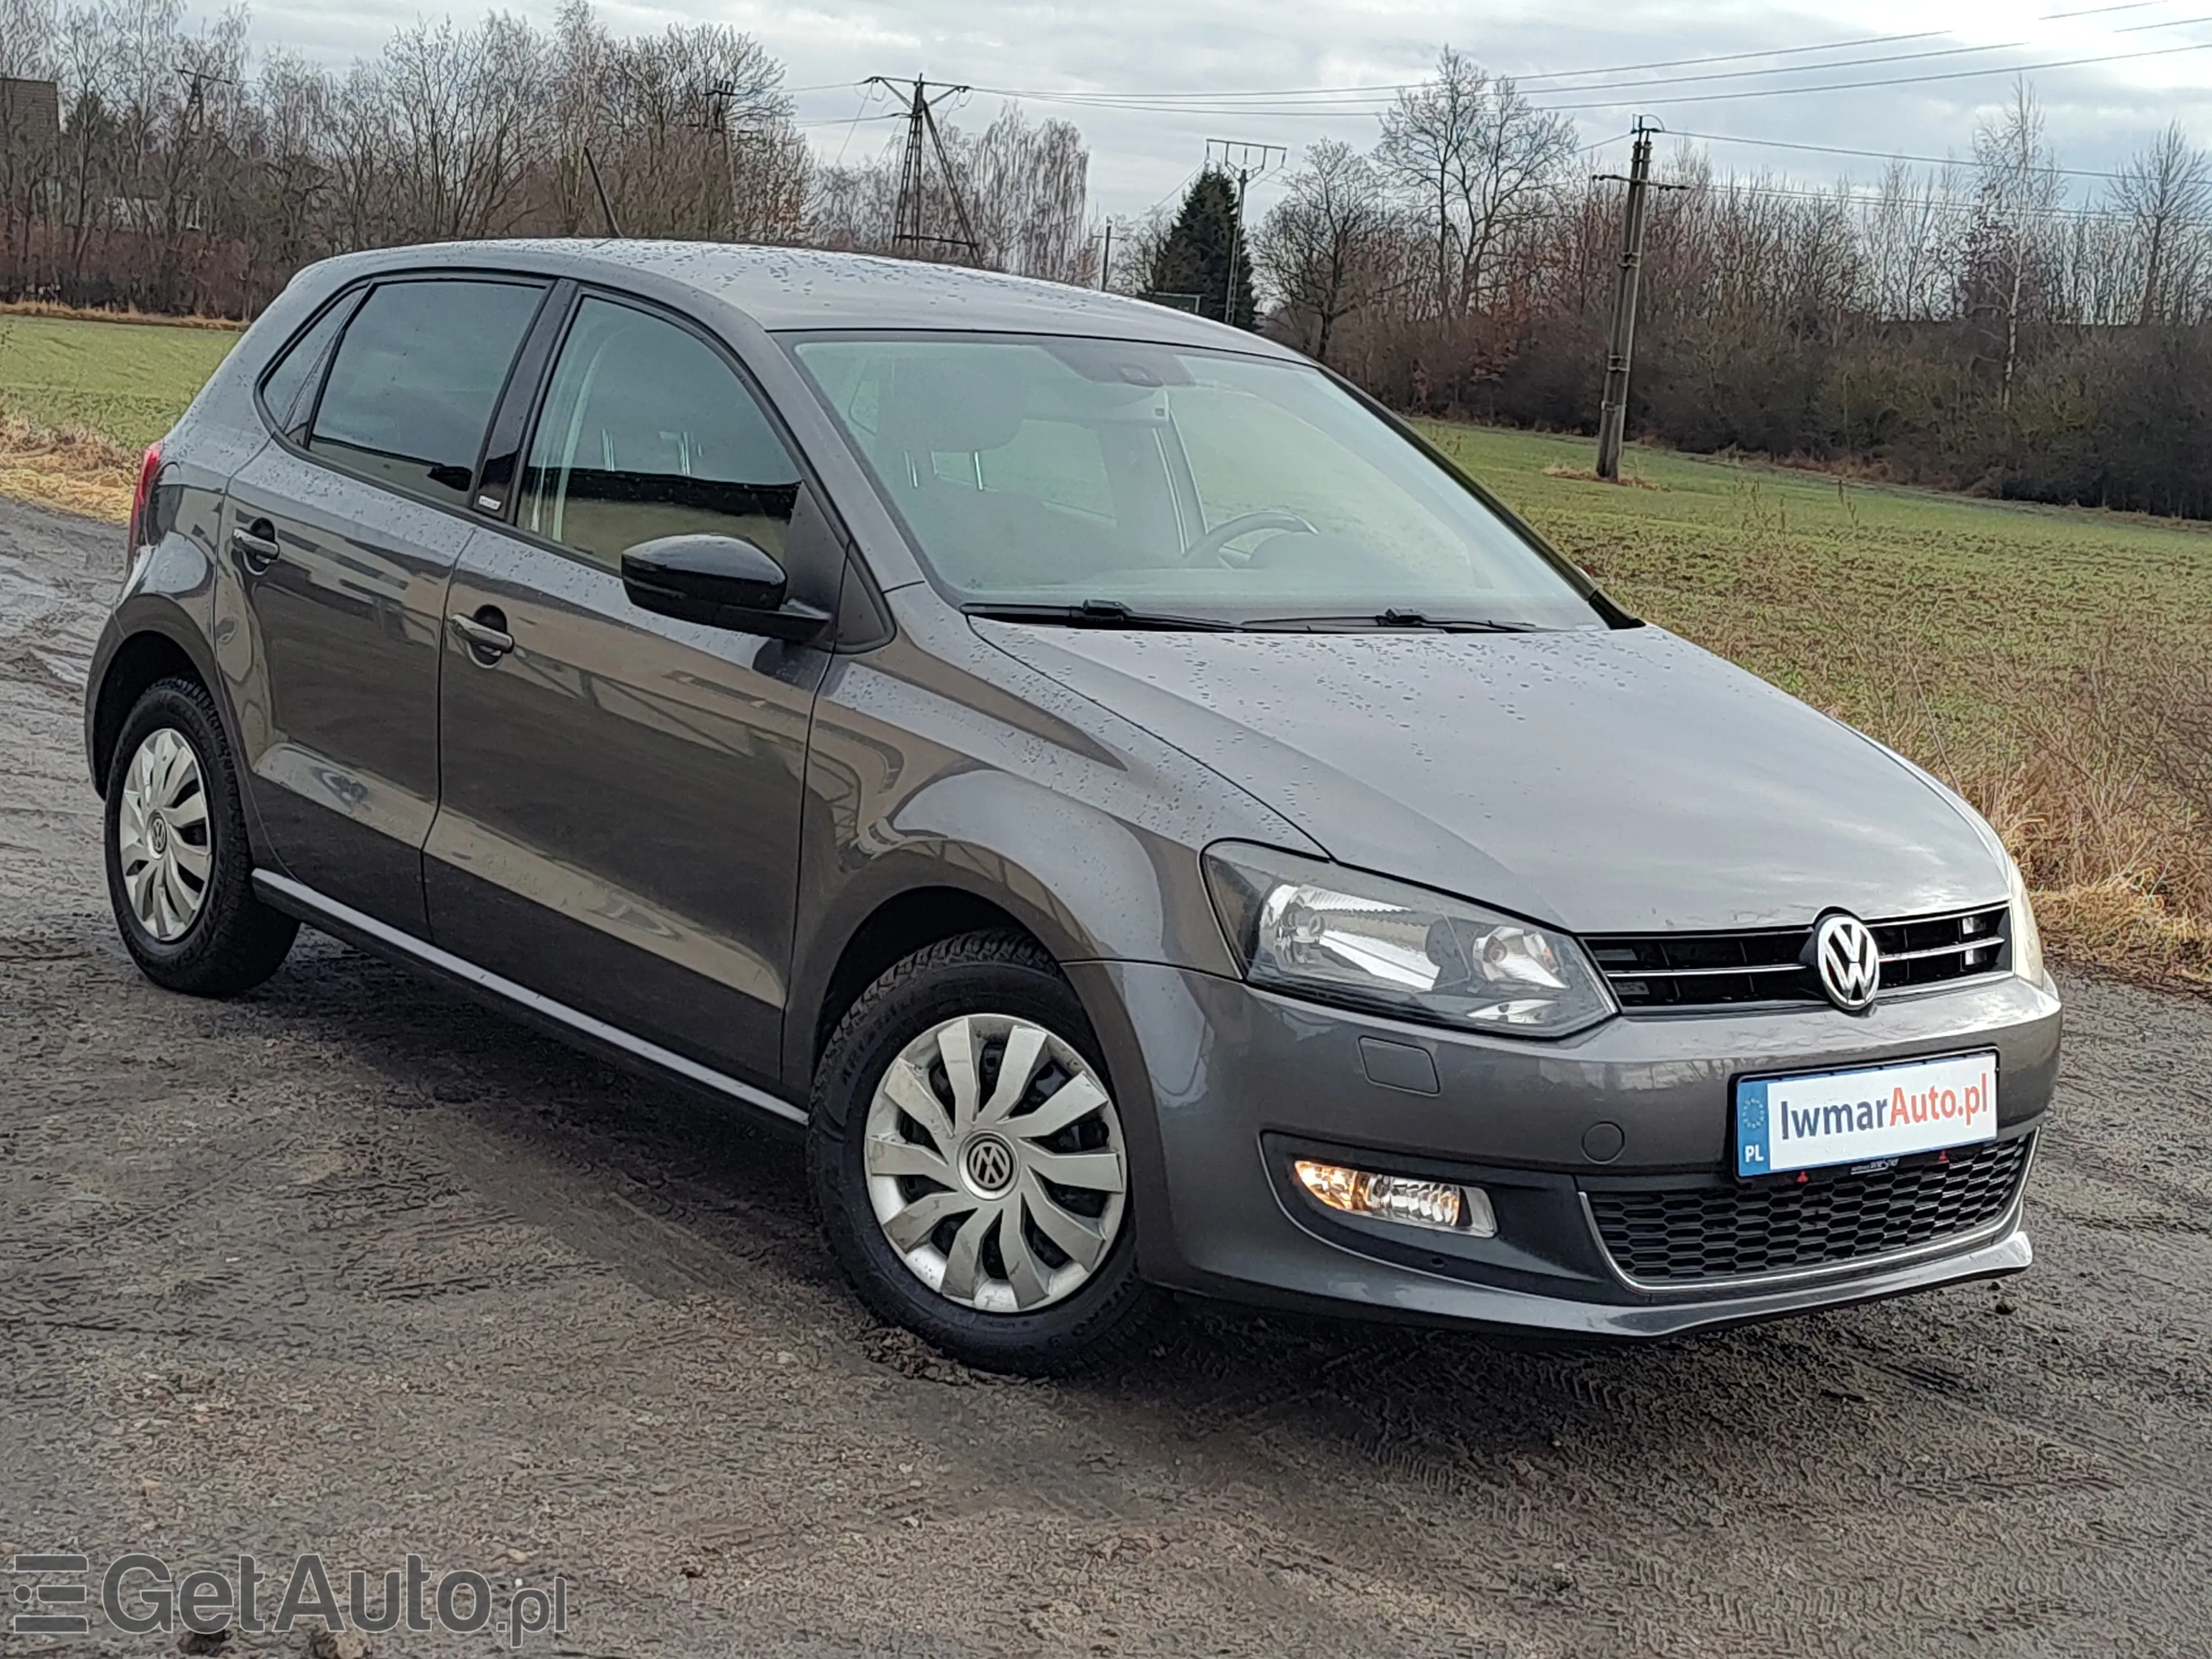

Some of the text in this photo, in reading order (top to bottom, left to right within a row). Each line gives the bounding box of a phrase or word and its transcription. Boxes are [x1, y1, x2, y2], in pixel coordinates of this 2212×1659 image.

[1819, 916, 1880, 1006] VW
[1781, 1073, 1987, 1140] IwmarAuto.pl
[1744, 1144, 1764, 1162] PL
